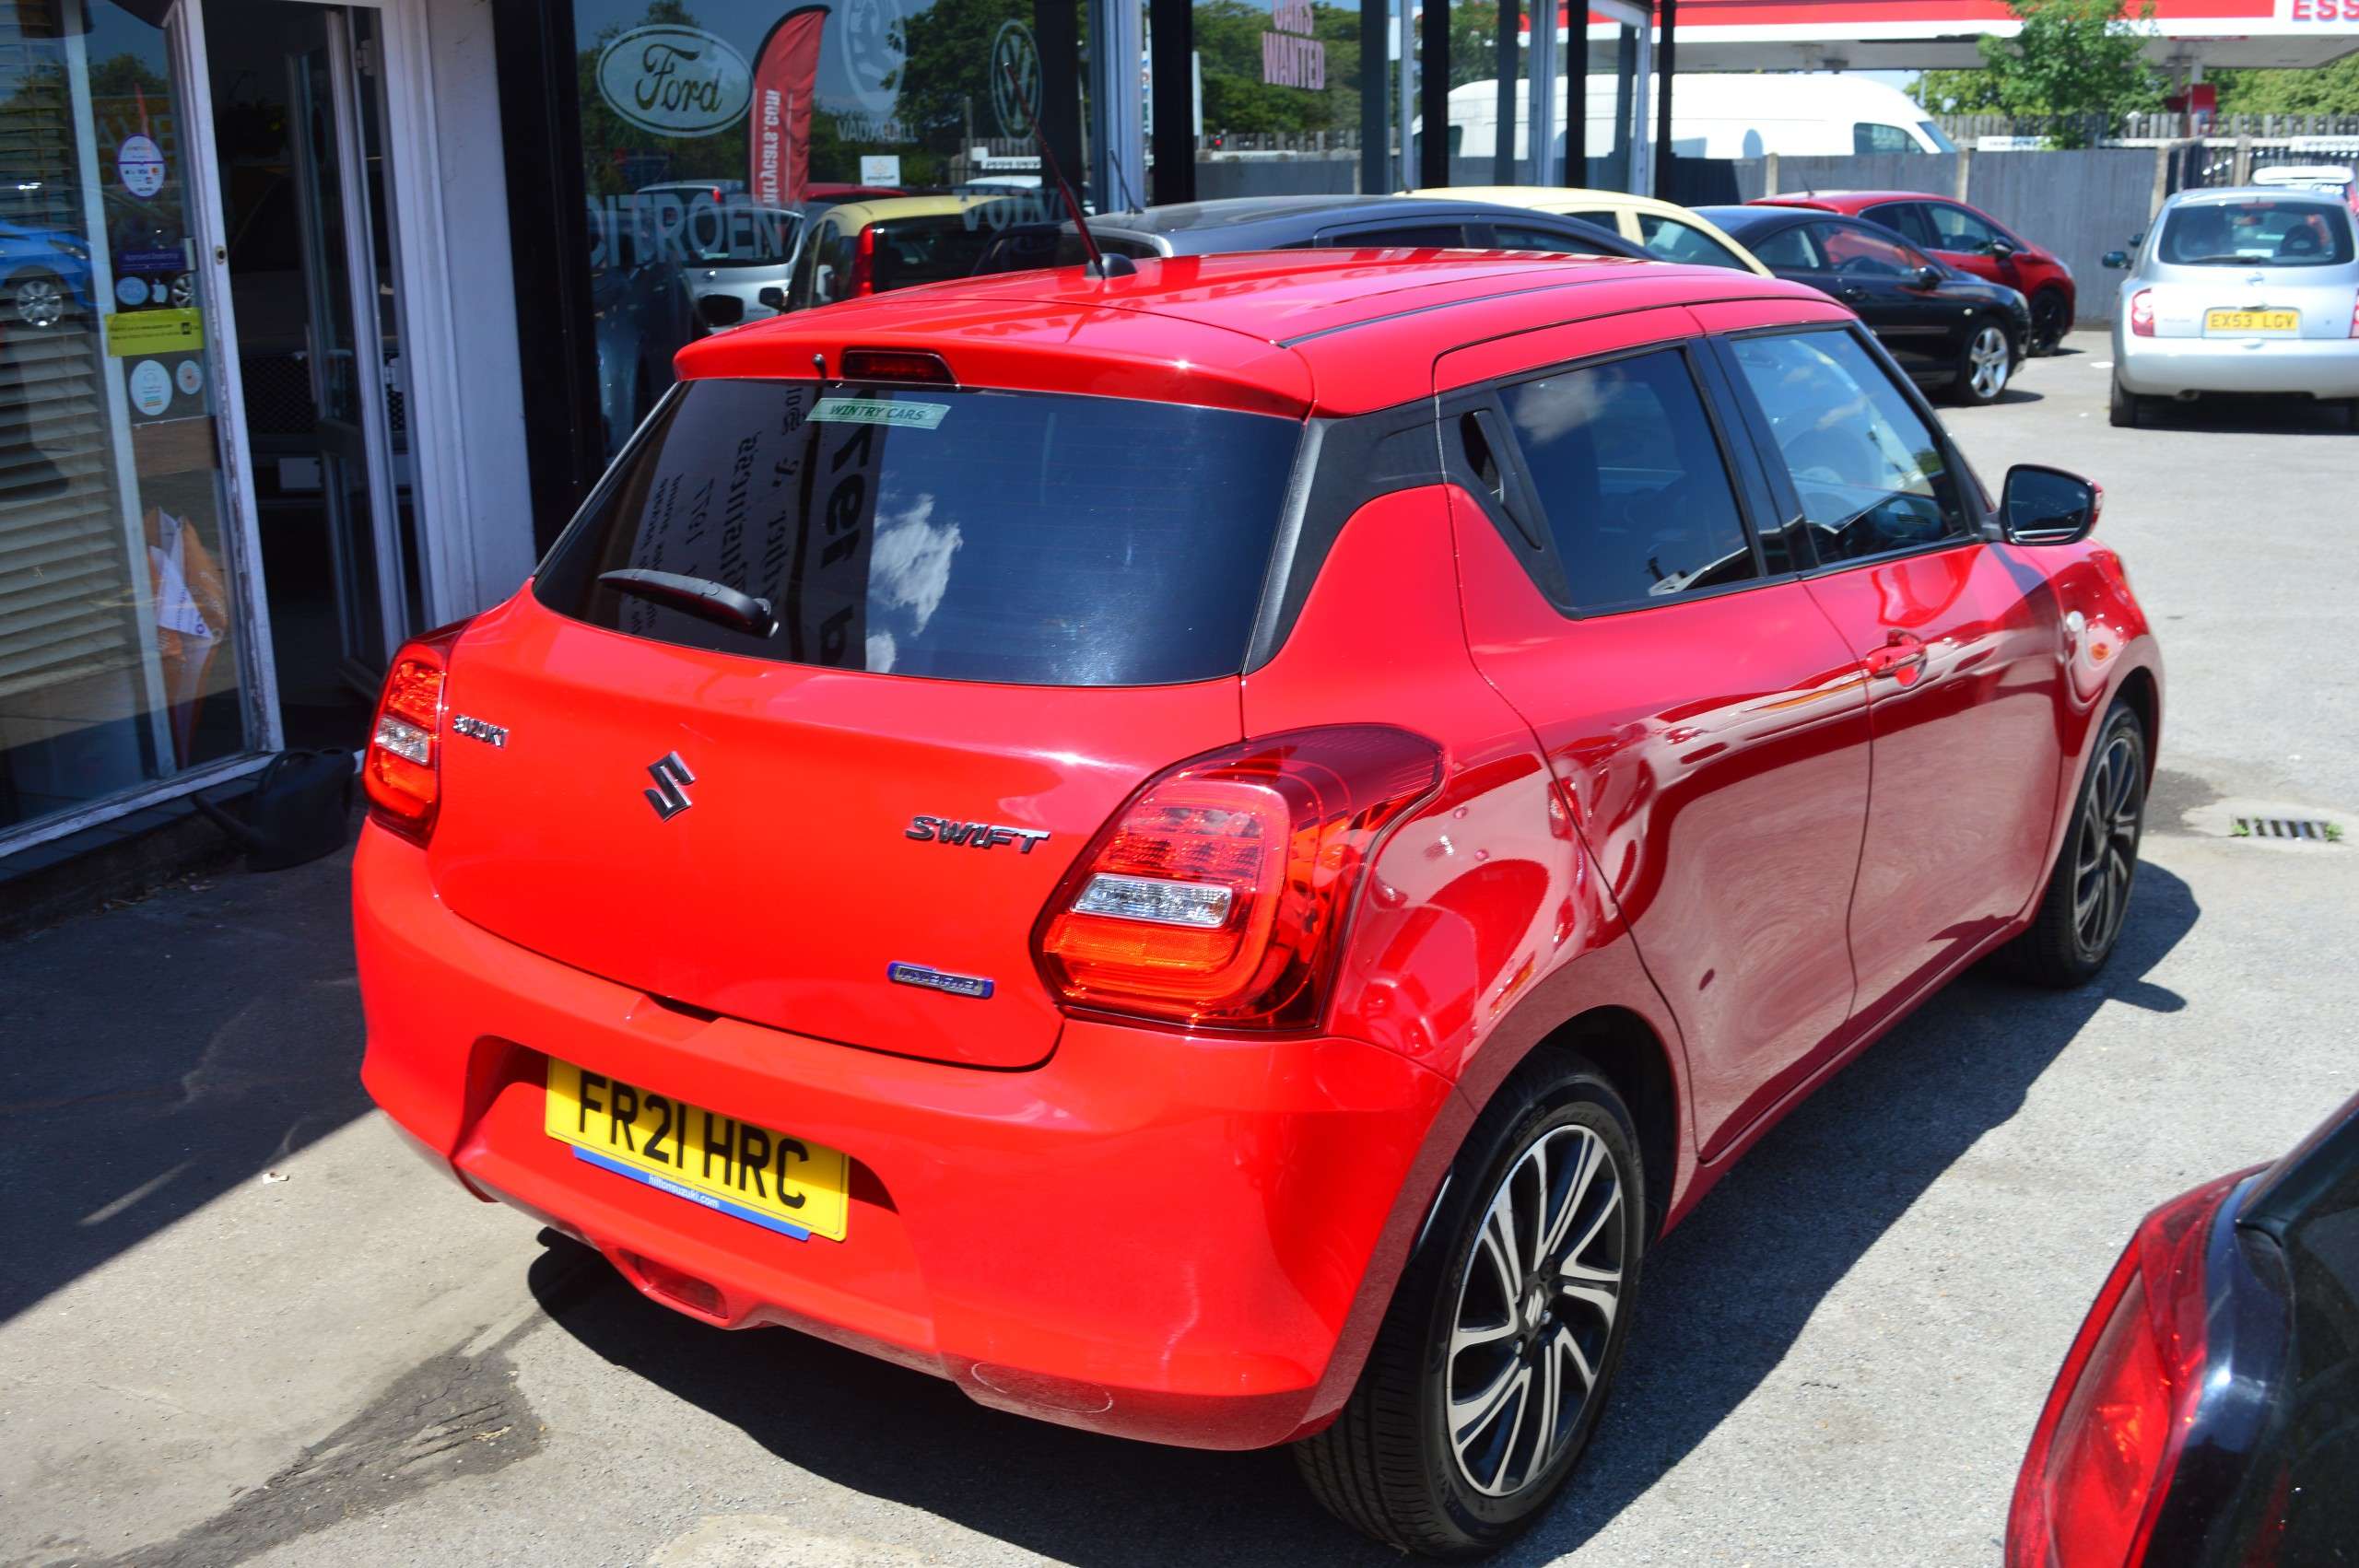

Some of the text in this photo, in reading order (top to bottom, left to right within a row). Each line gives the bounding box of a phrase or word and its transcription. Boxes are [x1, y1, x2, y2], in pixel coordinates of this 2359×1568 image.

[635, 43, 723, 112] Ford
[1262, 30, 1325, 89] WANTED
[2211, 313, 2253, 328] EX53
[831, 404, 926, 421] WINTRY CARS
[906, 814, 1051, 853] SWIFT
[579, 1070, 810, 1210] FR21 HRC
